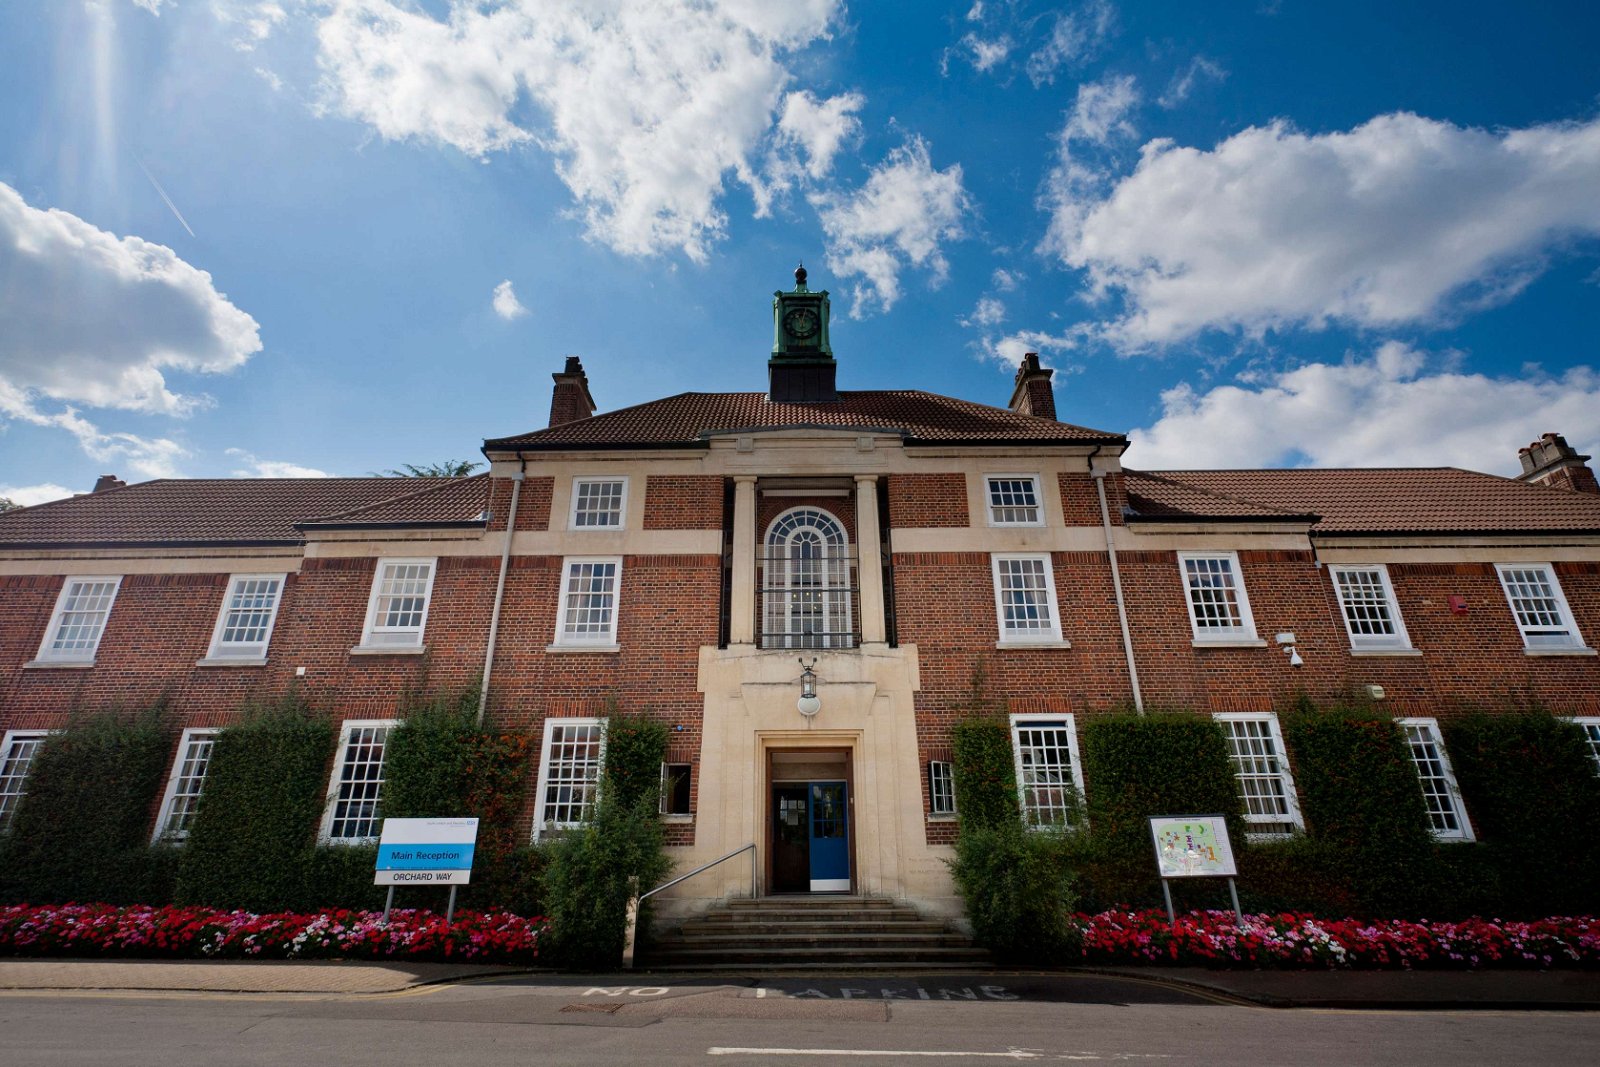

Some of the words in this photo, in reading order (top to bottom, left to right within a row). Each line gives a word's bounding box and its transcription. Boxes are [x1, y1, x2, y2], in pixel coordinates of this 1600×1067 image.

[391, 851, 412, 860] Main
[416, 851, 460, 862] Reception
[393, 873, 433, 881] ORCHARD
[436, 873, 452, 881] WAY
[582, 986, 670, 997] NO
